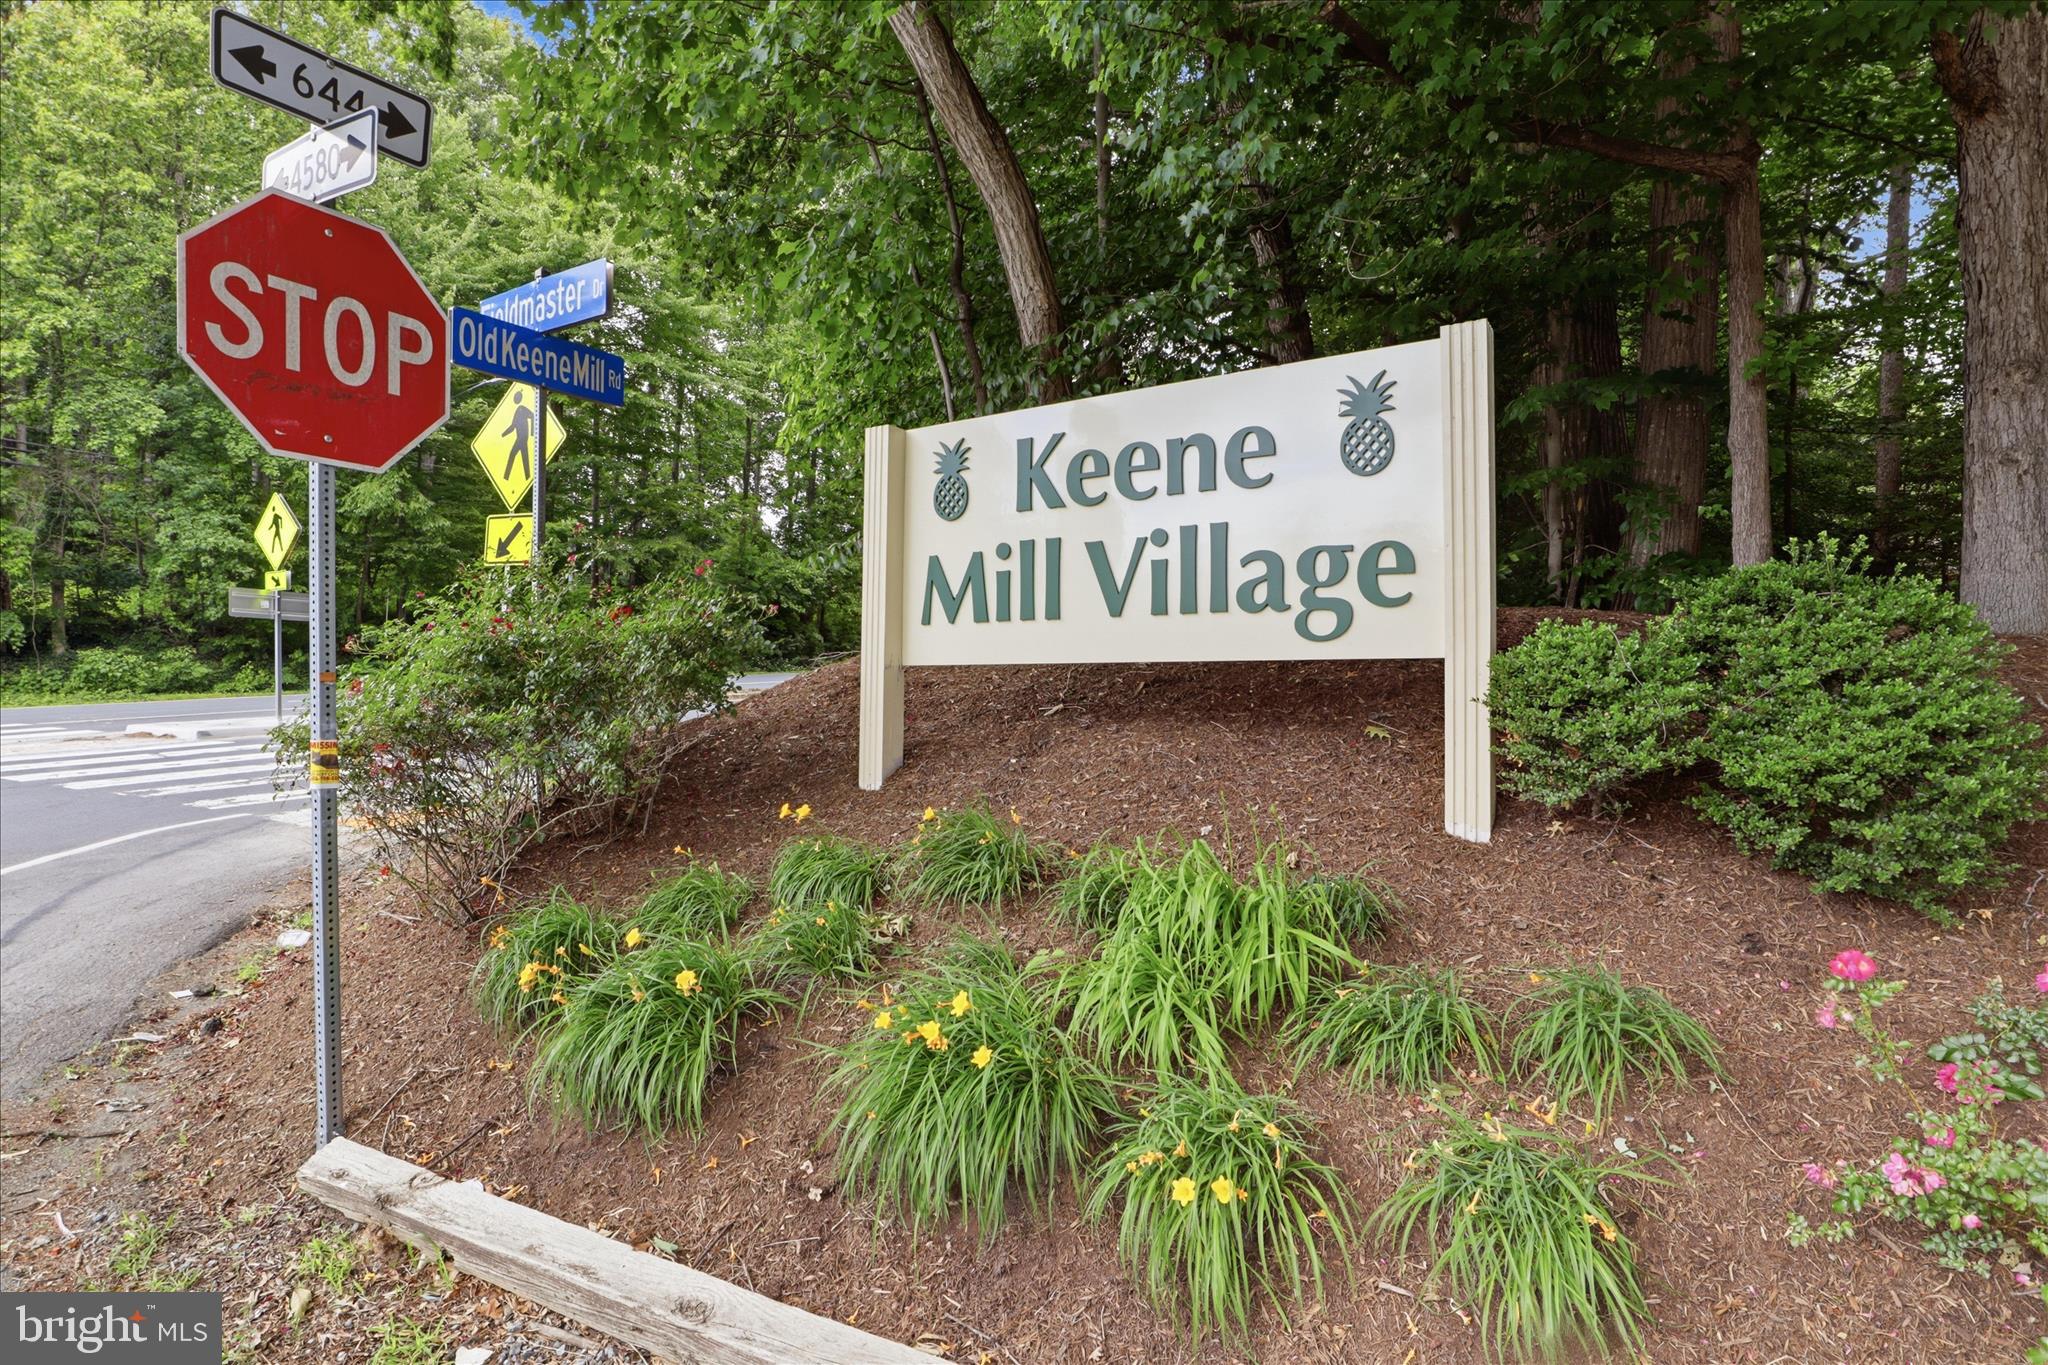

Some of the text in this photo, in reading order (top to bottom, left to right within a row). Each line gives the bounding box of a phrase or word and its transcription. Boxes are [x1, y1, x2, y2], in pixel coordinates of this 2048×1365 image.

[292, 63, 365, 113] 644
[290, 143, 340, 193] 4580
[481, 278, 605, 327] ldmaster Dr
[204, 261, 433, 397] STOP
[608, 370, 622, 390] Rd
[1016, 425, 1277, 512] Keene
[921, 521, 1417, 642] Mill Village
